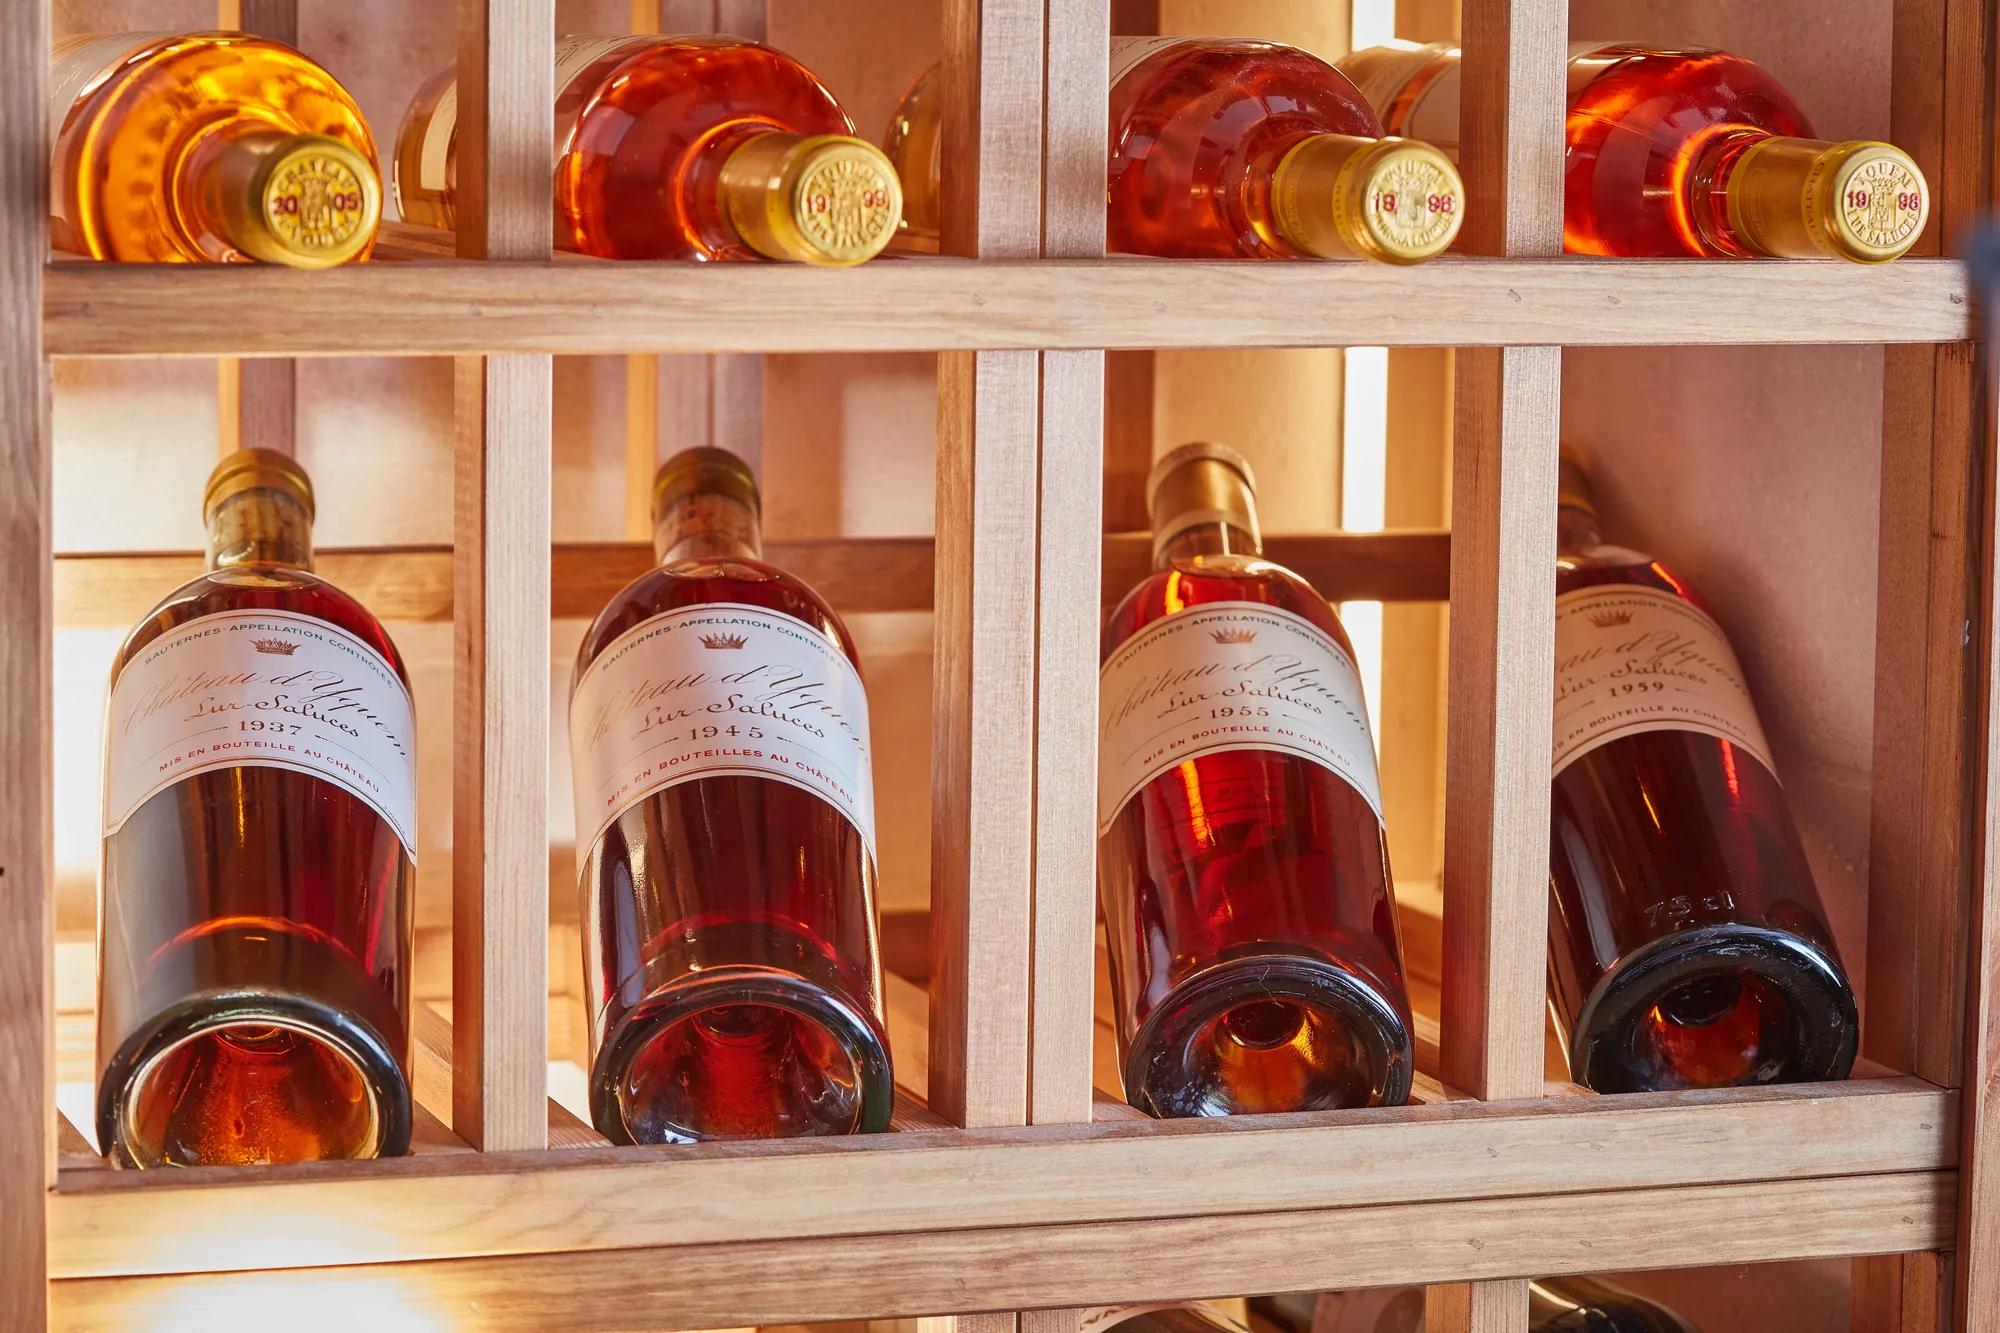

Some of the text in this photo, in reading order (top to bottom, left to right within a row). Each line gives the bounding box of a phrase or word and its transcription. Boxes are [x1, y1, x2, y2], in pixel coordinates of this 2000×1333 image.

[1853, 161, 1912, 190] YQUEM
[273, 192, 359, 216] 20 05
[807, 194, 827, 215] 19
[1373, 191, 1396, 213] 19
[1847, 190, 1867, 208] 19
[1157, 680, 1322, 719] Lur-Saluces
[1609, 681, 1665, 698] 1959
[184, 694, 359, 738] Lur-Saluces
[632, 693, 824, 740] Lur-Saluces
[1210, 706, 1270, 720] 1955
[1568, 727, 1584, 740] EN
[1589, 704, 1665, 729] BOUTEILLE
[1671, 705, 1689, 714] AU
[239, 720, 302, 736] 1937
[689, 725, 764, 742] 1945
[159, 756, 181, 773] MIS
[188, 747, 205, 758] EN
[212, 740, 296, 752] BOUTEILLE
[304, 748, 322, 759] AU
[1143, 749, 1164, 766] MIS
[1170, 738, 1186, 750] EN
[1192, 725, 1270, 741] BOUTEILLE
[1277, 728, 1294, 737] AU
[607, 784, 629, 807] MIS
[634, 768, 652, 784] EN
[659, 748, 763, 771] BOUTEILLES
[769, 753, 790, 764] AU
